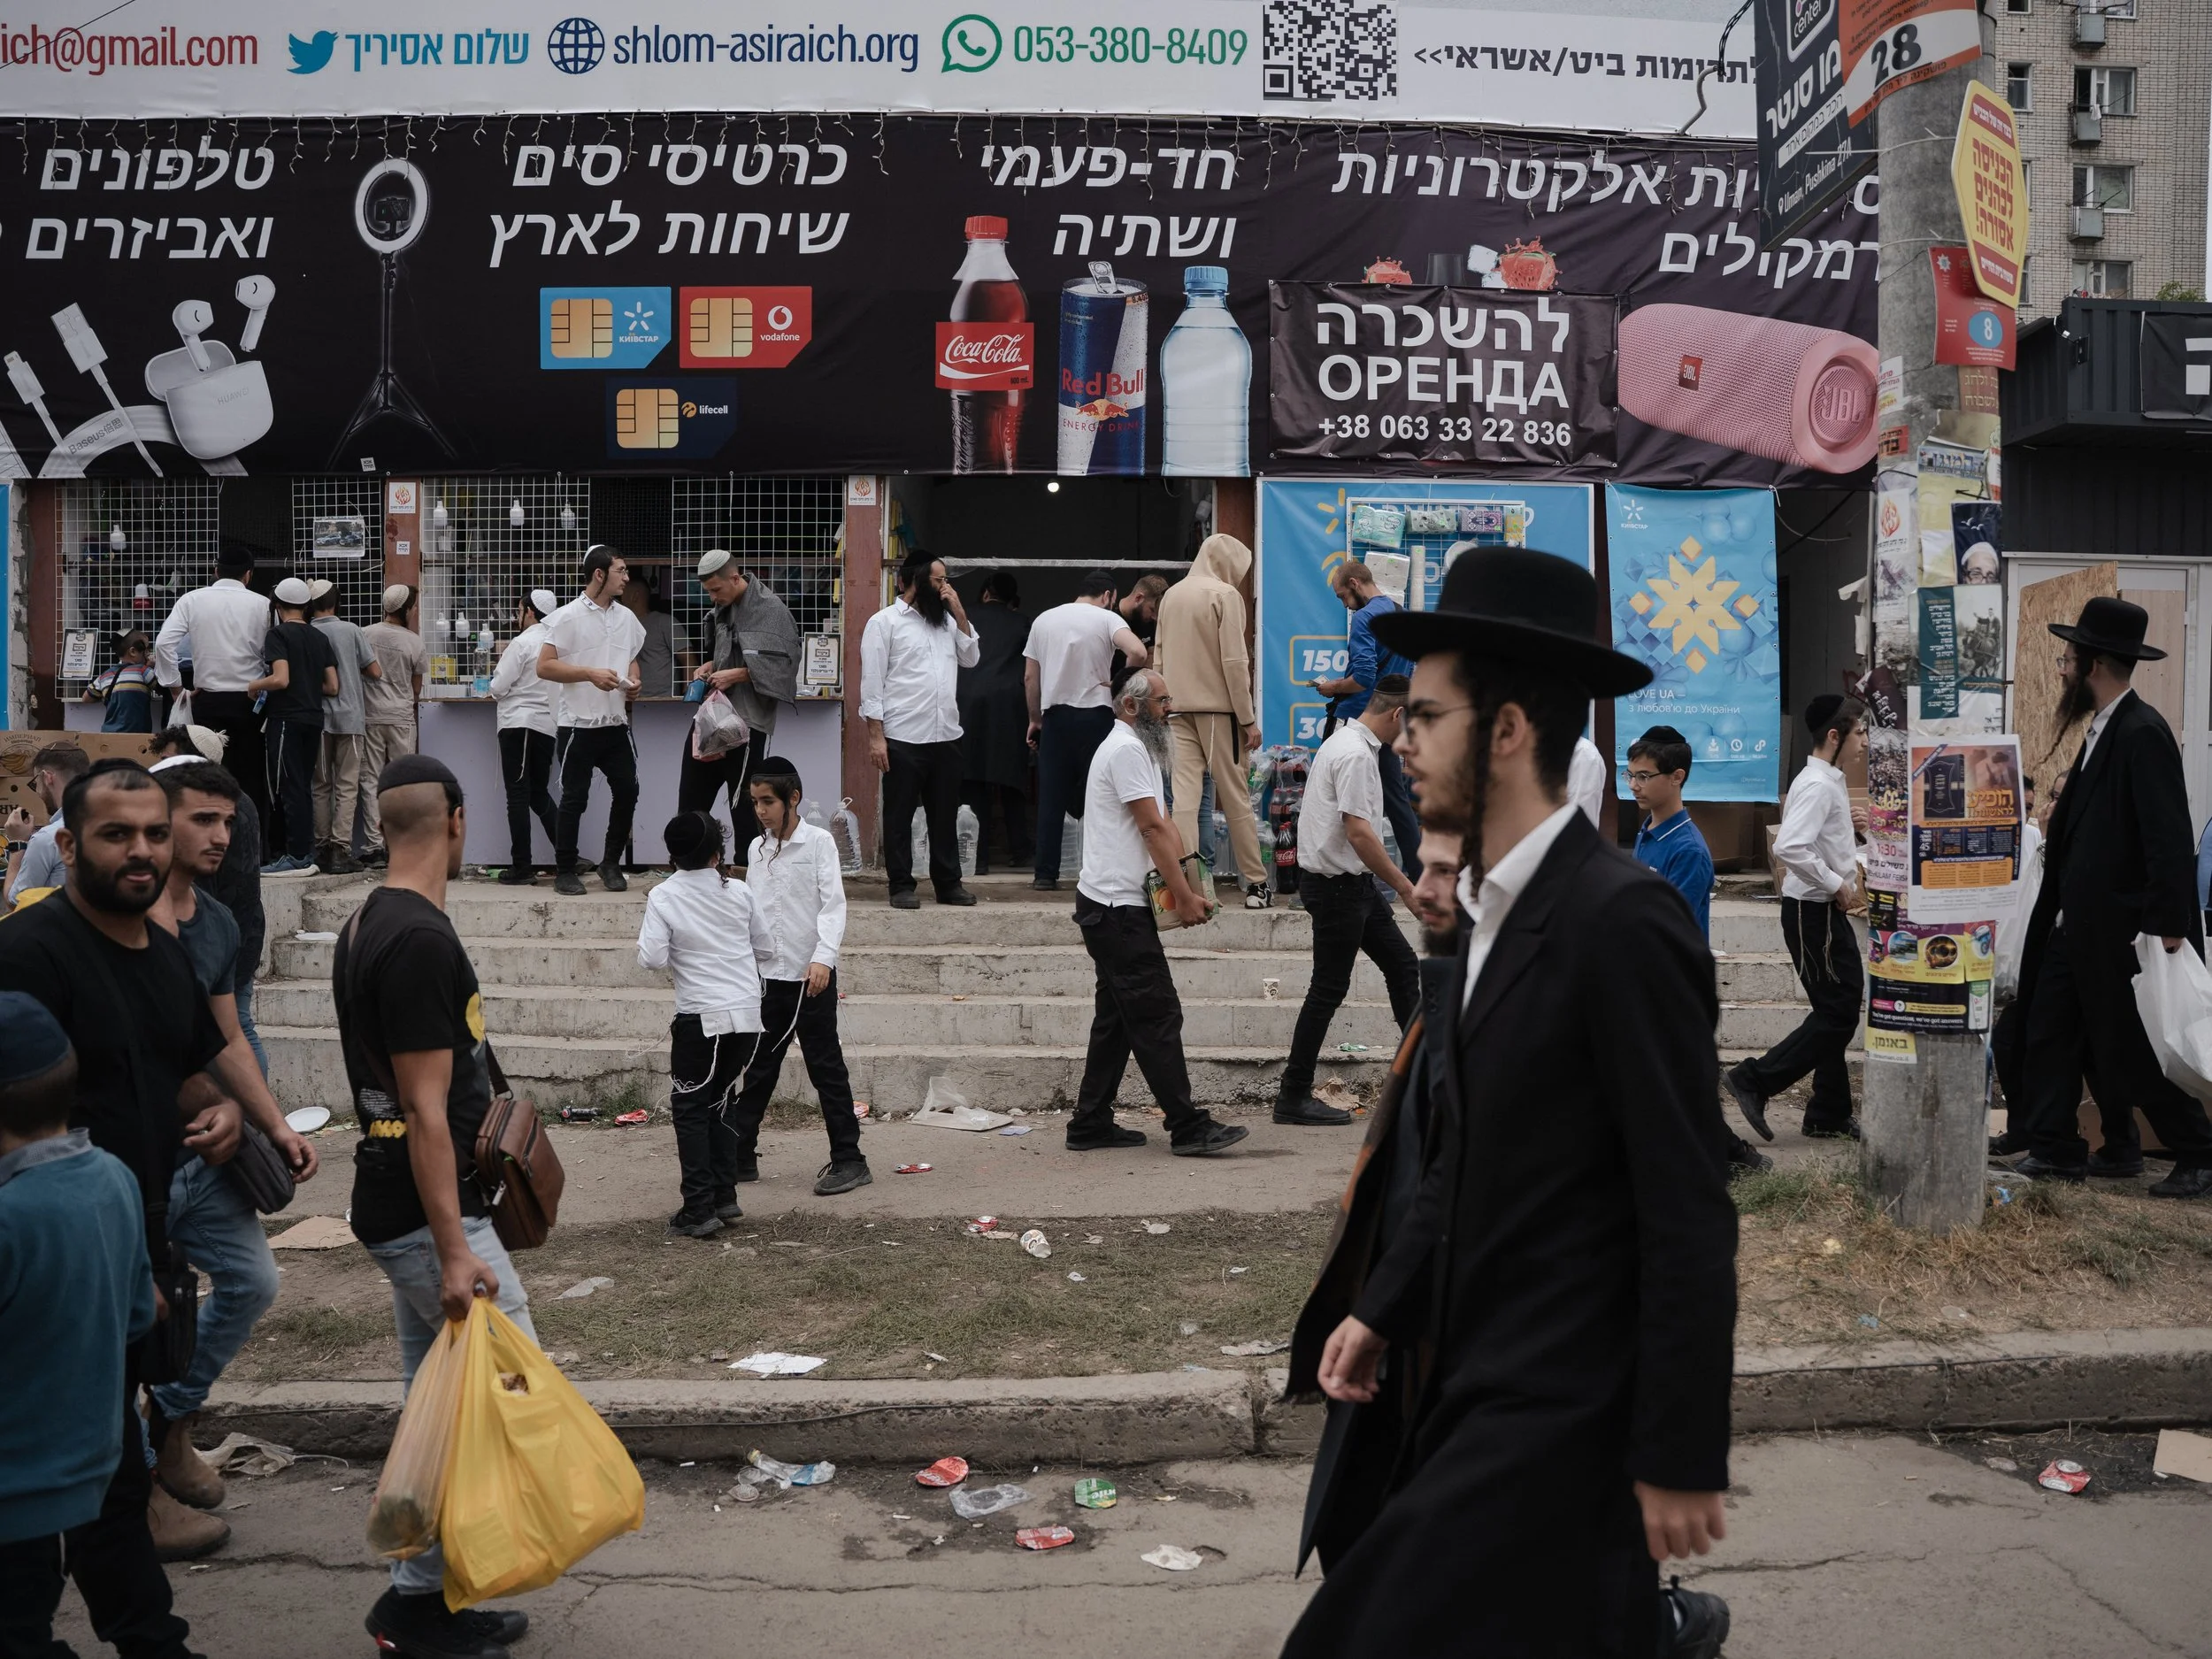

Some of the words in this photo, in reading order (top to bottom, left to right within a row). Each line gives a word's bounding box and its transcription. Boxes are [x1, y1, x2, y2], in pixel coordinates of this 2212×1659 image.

[344, 33, 443, 73] אסיריך
[453, 27, 529, 65] שלום
[613, 23, 918, 73] shlom-asiraich.org
[1014, 26, 1248, 65] 053-380-8409
[1870, 24, 1922, 89] 28
[40, 142, 275, 191] טלפונים
[512, 145, 624, 187] סים
[648, 144, 848, 186] כרטיסי
[979, 144, 1237, 190] חד-פעמי
[1331, 150, 1668, 212] אלקטרוניות
[1805, 157, 1836, 195] Pushkina
[1972, 137, 2014, 189] הכניסה
[1974, 172, 2014, 220] לכהנים
[25, 217, 274, 259] ואביזרים
[489, 199, 641, 268] לארץ
[657, 212, 850, 255] שיחות
[1052, 214, 1237, 258] ושתיה
[1975, 202, 2015, 254] אסורה!
[760, 332, 801, 342] vodafone
[1317, 296, 1571, 353] להשכרה
[1983, 317, 1993, 341] 8
[945, 334, 1025, 365] Coca-Cola
[1063, 368, 1102, 396] Red
[1106, 369, 1144, 396] Bull
[1318, 354, 1570, 415] ОРЕНДА
[1683, 364, 1697, 381] JBL
[217, 387, 250, 405] HUAWEI
[699, 404, 728, 415] lifecell
[1821, 384, 1865, 423] JBL
[1063, 419, 1103, 432] ENERGY
[1318, 417, 1371, 440] +38
[1379, 417, 1430, 442] 063
[1438, 417, 1472, 442] 33
[1481, 417, 1516, 443] 22
[1523, 419, 1571, 447] 836
[1302, 649, 1349, 672] 150
[1659, 689, 1675, 700] UA
[1685, 705, 1698, 715] до
[1701, 704, 1741, 716] України
[1967, 788, 2014, 808] הופיע
[1919, 842, 1930, 851] 45
